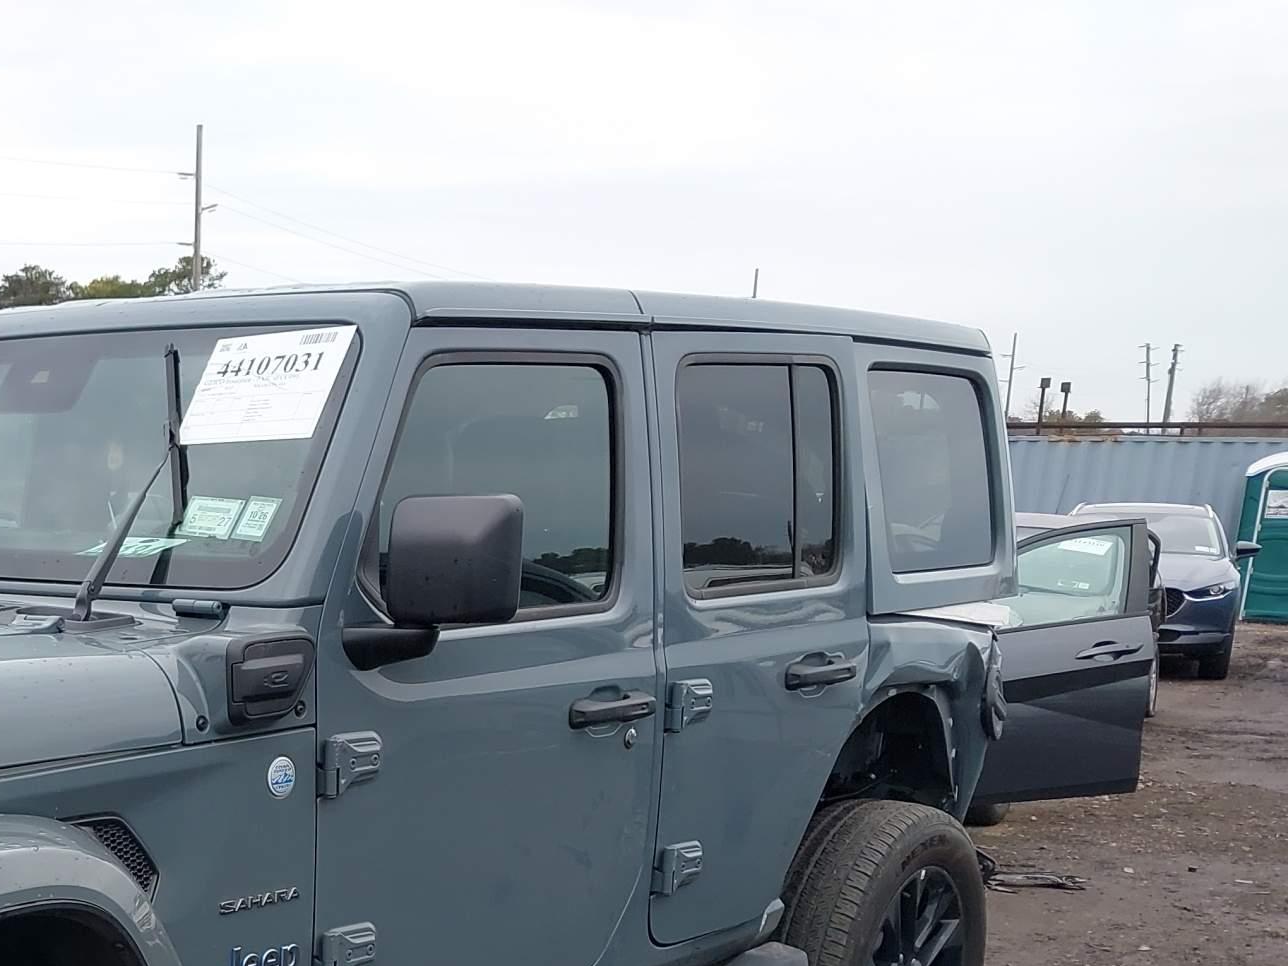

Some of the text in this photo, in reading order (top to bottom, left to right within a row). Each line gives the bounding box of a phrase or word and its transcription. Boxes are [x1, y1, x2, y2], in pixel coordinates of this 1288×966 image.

[216, 351, 326, 378] 44107031
[216, 516, 233, 528] 27
[218, 886, 301, 915] SAHARA
